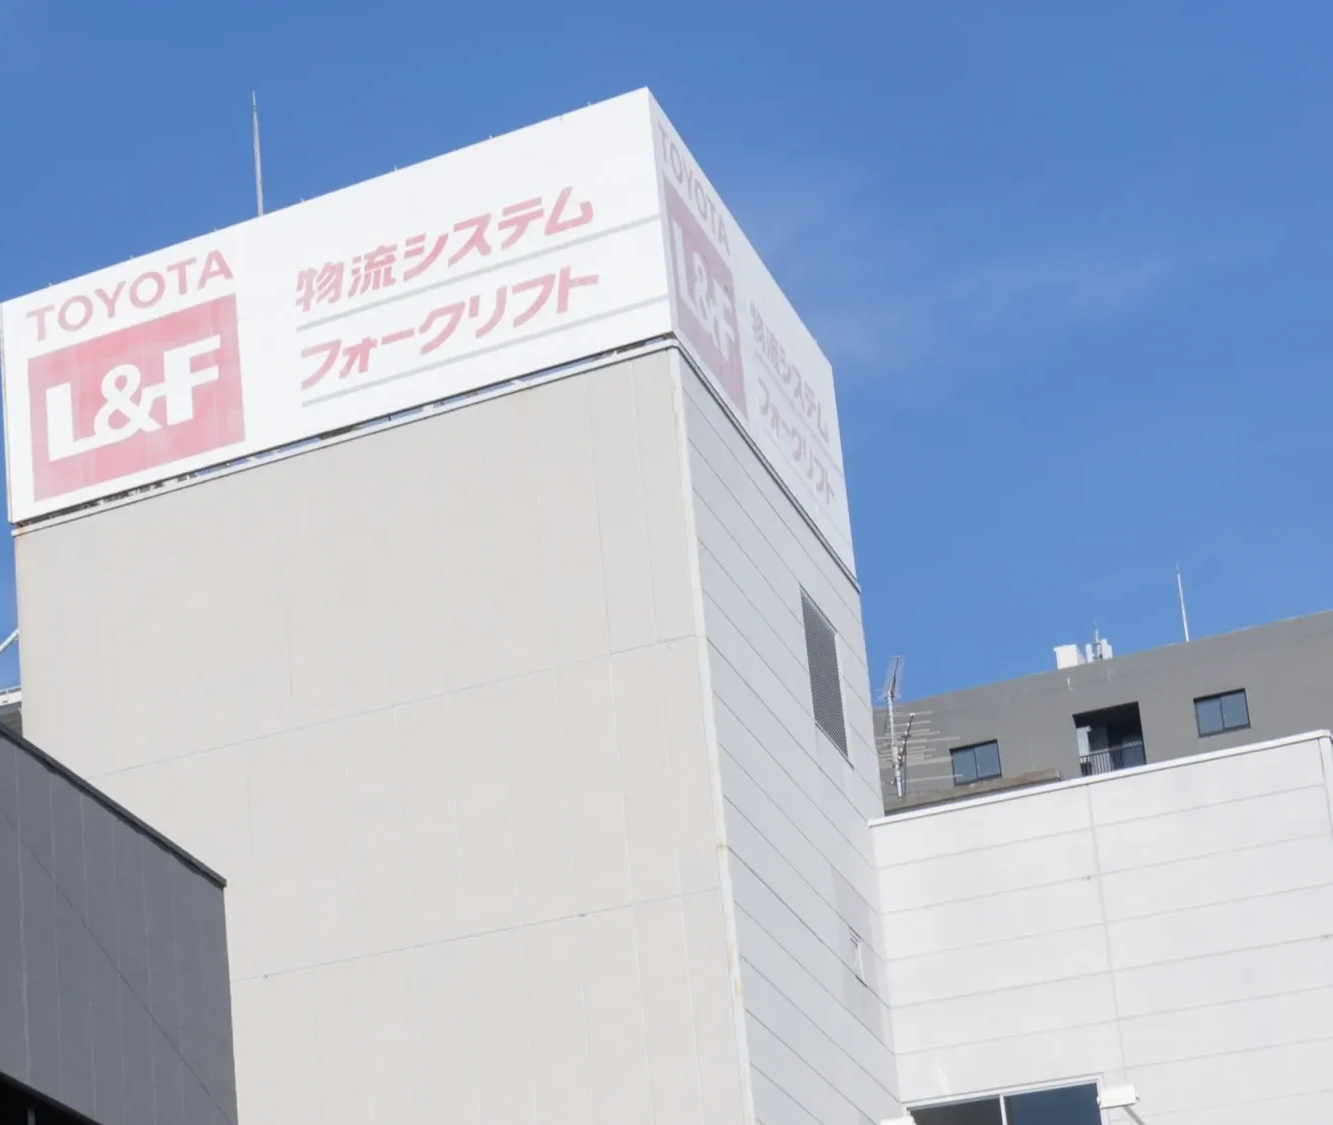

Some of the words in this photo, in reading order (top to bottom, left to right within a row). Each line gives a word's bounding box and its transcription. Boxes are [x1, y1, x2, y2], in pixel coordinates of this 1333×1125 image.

[295, 186, 594, 312] 物流システム
[657, 120, 731, 256] TOYOTA
[27, 248, 234, 342] TOYOTA
[300, 267, 600, 391] フォークリフト
[45, 334, 223, 463] L&F
